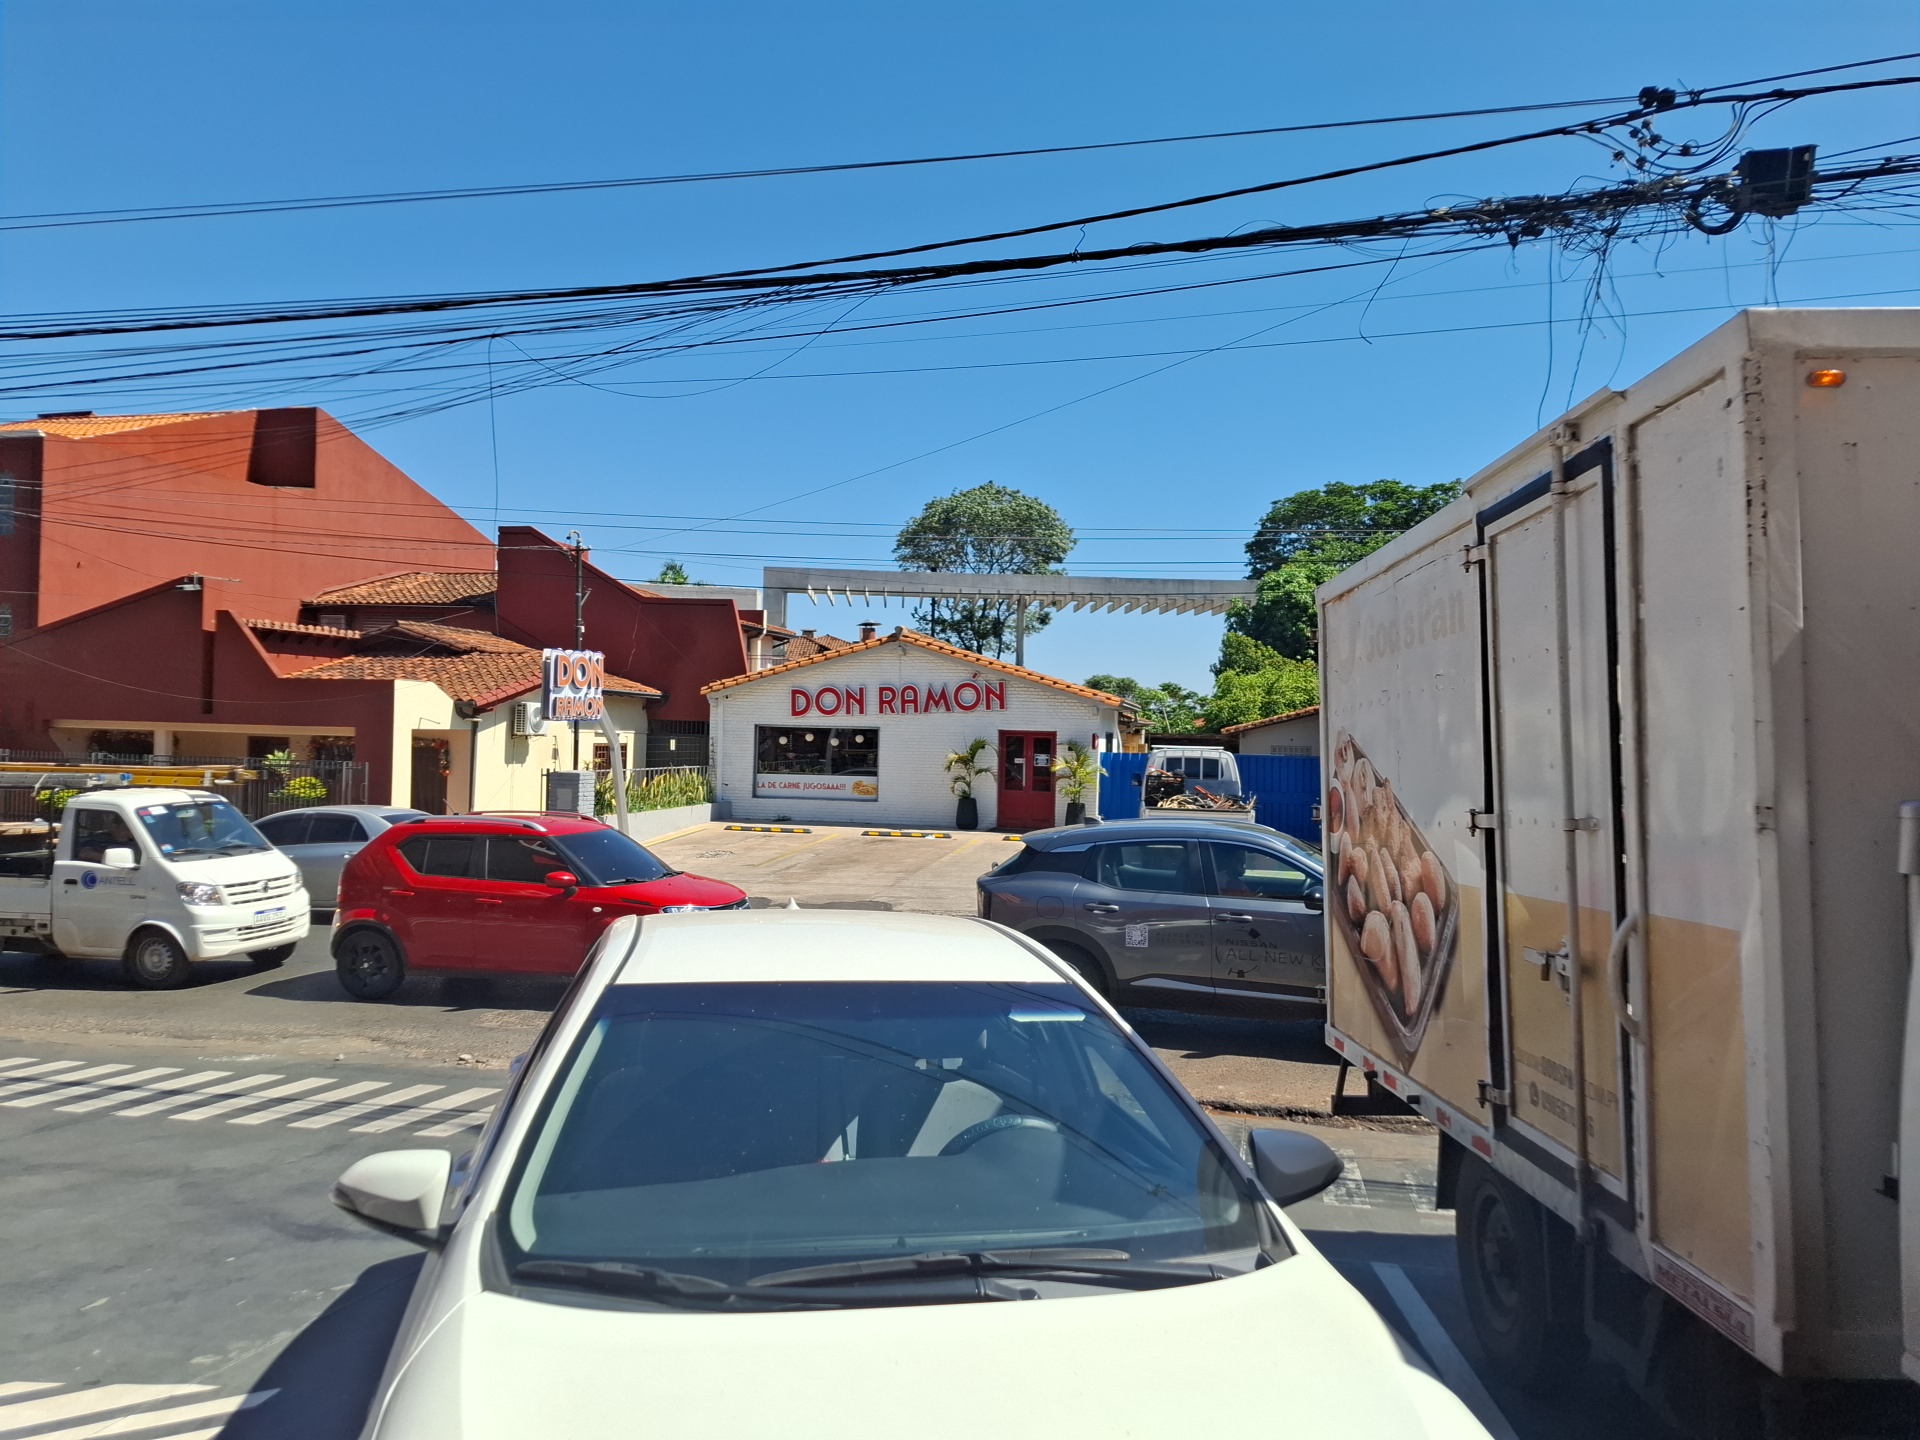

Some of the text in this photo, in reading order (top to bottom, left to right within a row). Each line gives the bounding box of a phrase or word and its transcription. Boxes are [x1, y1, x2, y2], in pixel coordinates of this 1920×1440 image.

[557, 655, 605, 689] DON
[789, 671, 1007, 717] DON RAMÓN
[768, 781, 777, 789] DE
[778, 781, 801, 790] CARNE
[1225, 938, 1279, 949] NISSAN
[1226, 947, 1259, 962] ALL
[1264, 950, 1304, 966] NEW
